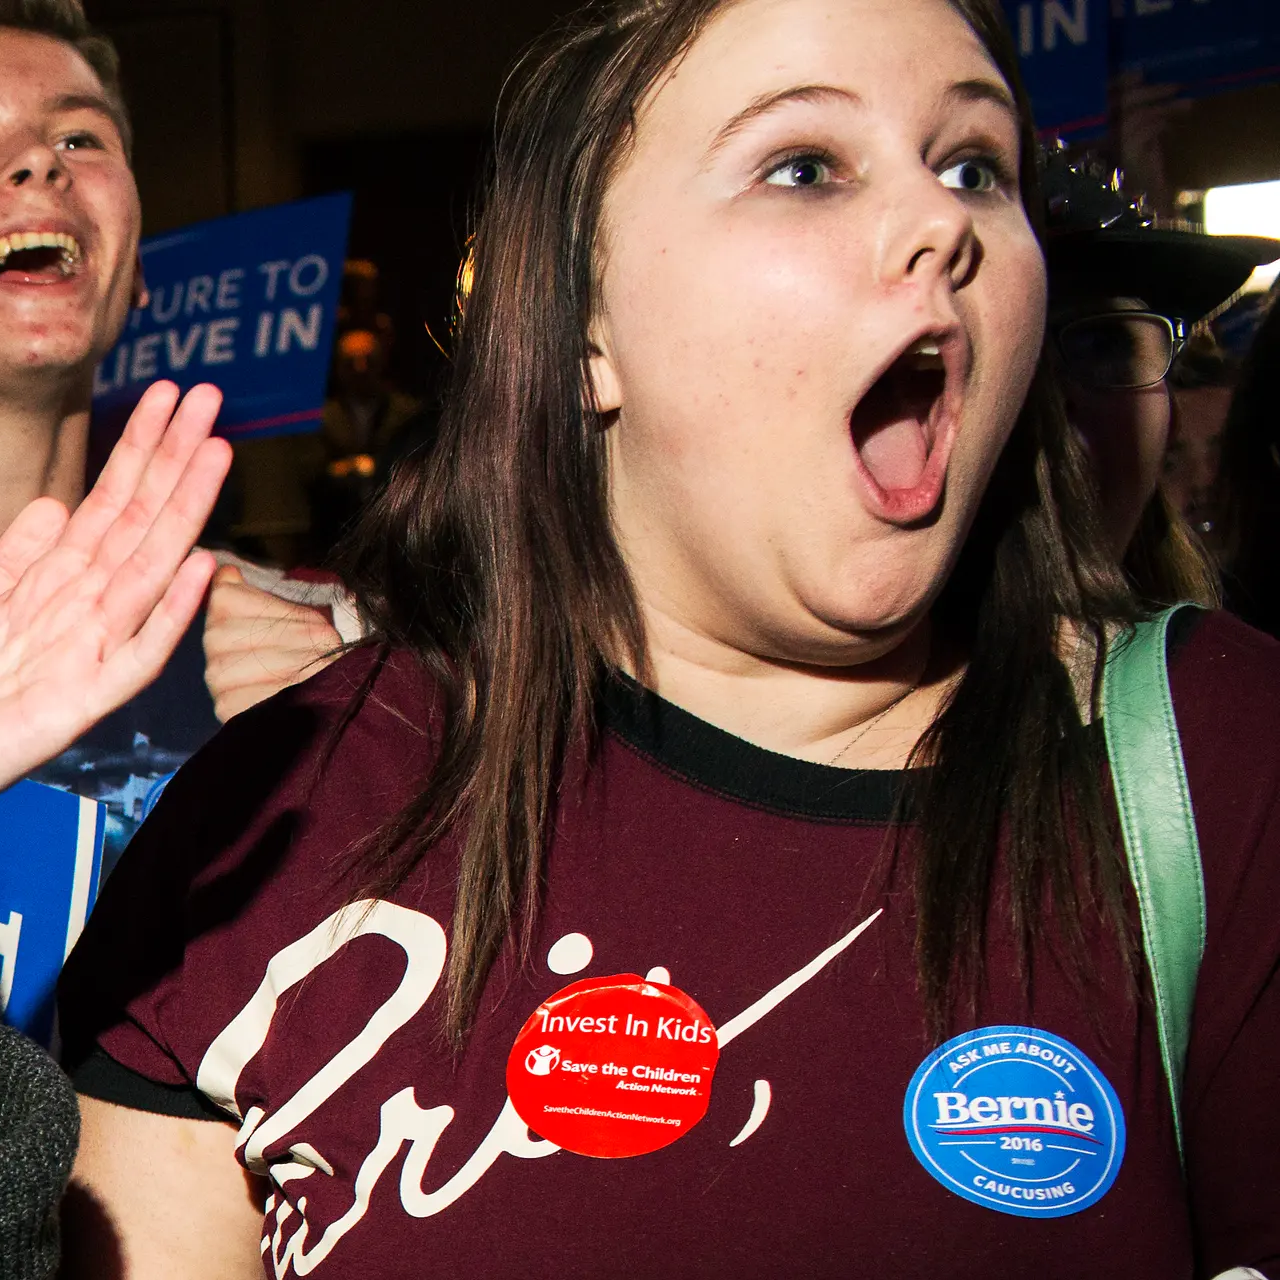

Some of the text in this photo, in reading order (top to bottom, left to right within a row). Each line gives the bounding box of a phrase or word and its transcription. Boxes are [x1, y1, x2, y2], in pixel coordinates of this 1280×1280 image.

[131, 253, 329, 328] URE TO
[92, 303, 323, 398] LIEVE IN
[540, 1011, 713, 1044] Invest In Kids
[561, 1060, 701, 1084] Save the Children
[948, 1041, 1078, 1075] ASK ME ABOUT
[616, 1080, 697, 1097] Action Network
[543, 1105, 682, 1127] SavetheChildrenActionNetwork.org
[932, 1090, 1095, 1132] Bernie
[1000, 1136, 1043, 1152] 2016
[972, 1174, 1076, 1201] CAUCUSING
